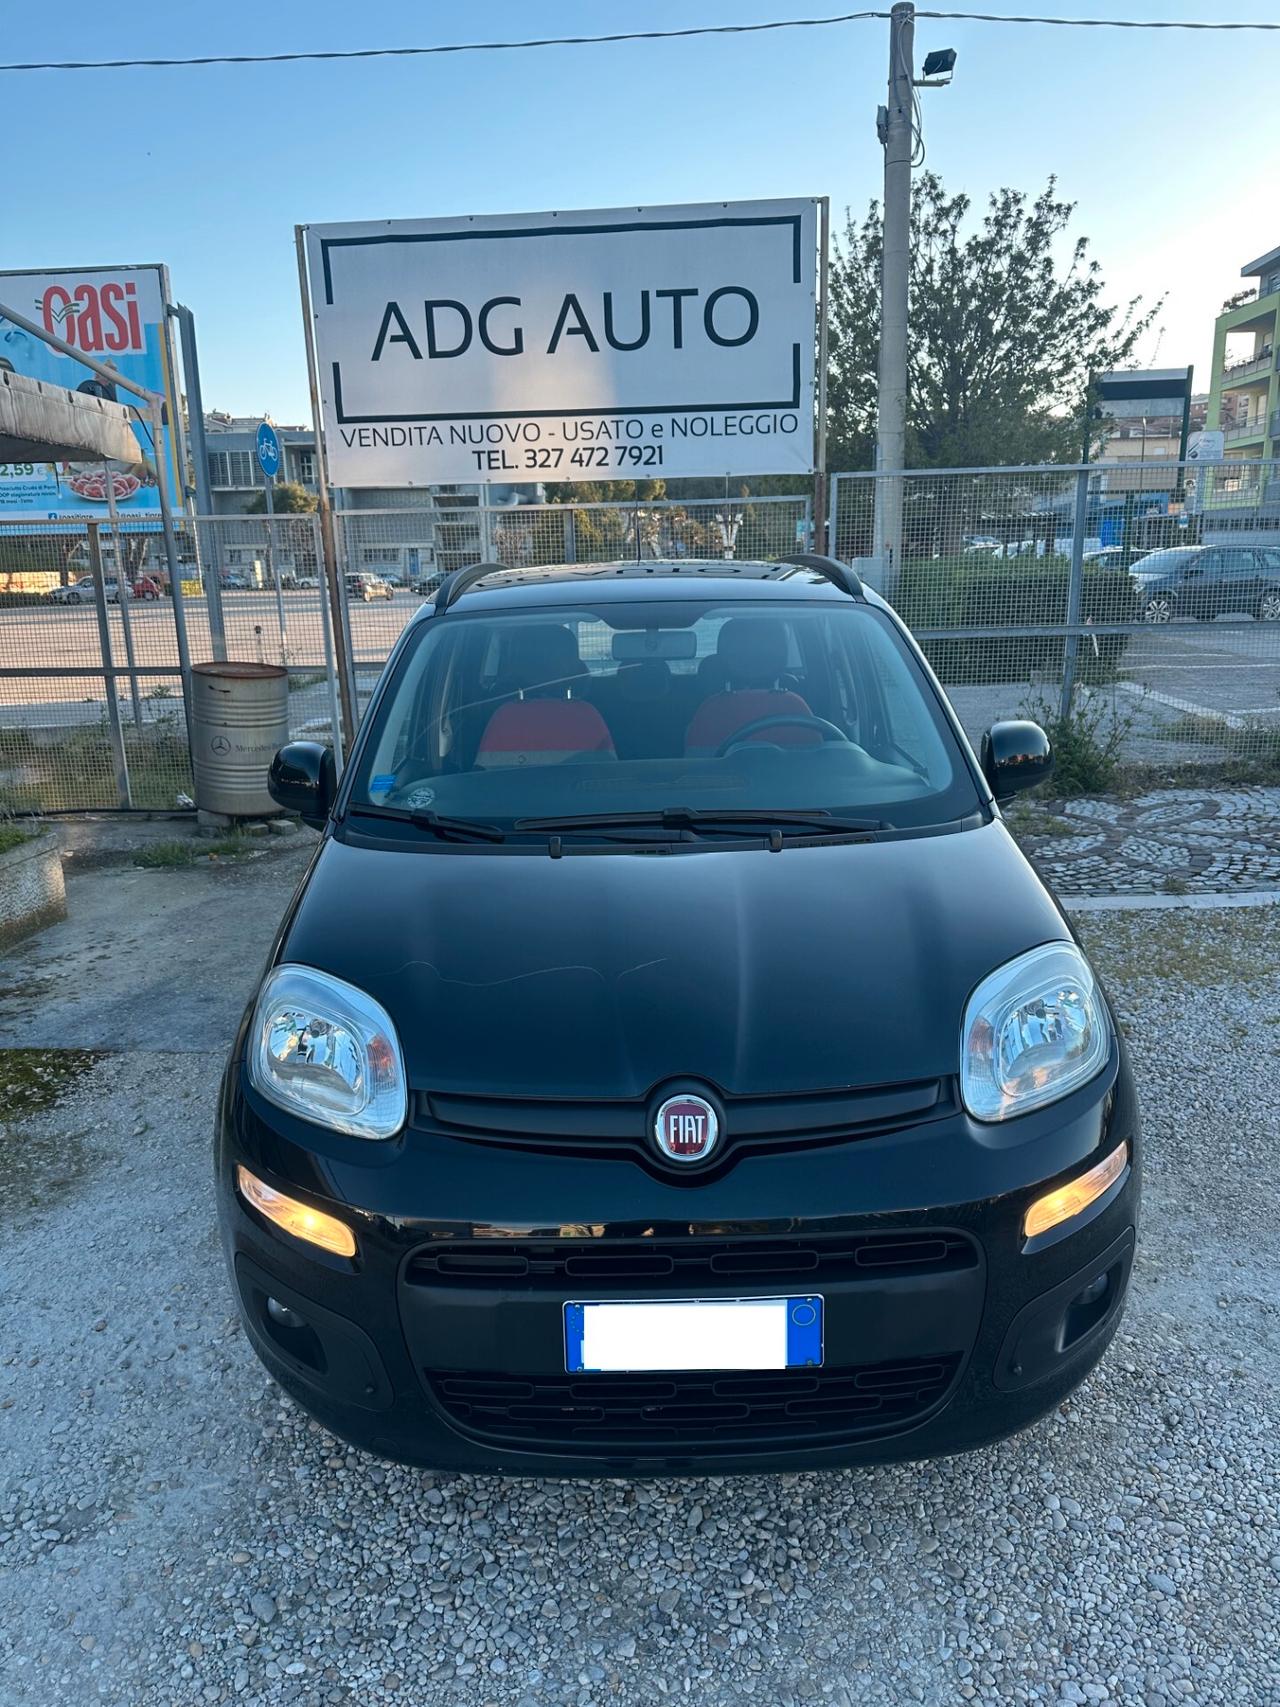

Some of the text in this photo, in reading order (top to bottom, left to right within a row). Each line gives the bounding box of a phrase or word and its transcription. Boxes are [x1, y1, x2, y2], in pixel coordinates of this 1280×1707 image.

[371, 285, 760, 361] ADG AUTO
[339, 425, 444, 449] VENDITA
[449, 422, 541, 445] NUOVO
[562, 418, 644, 442] USATO
[650, 423, 664, 439] e
[671, 413, 799, 439] NOLEGGIO
[472, 444, 664, 471] TEL. 327 472 7921
[669, 1114, 705, 1144] FIAT
